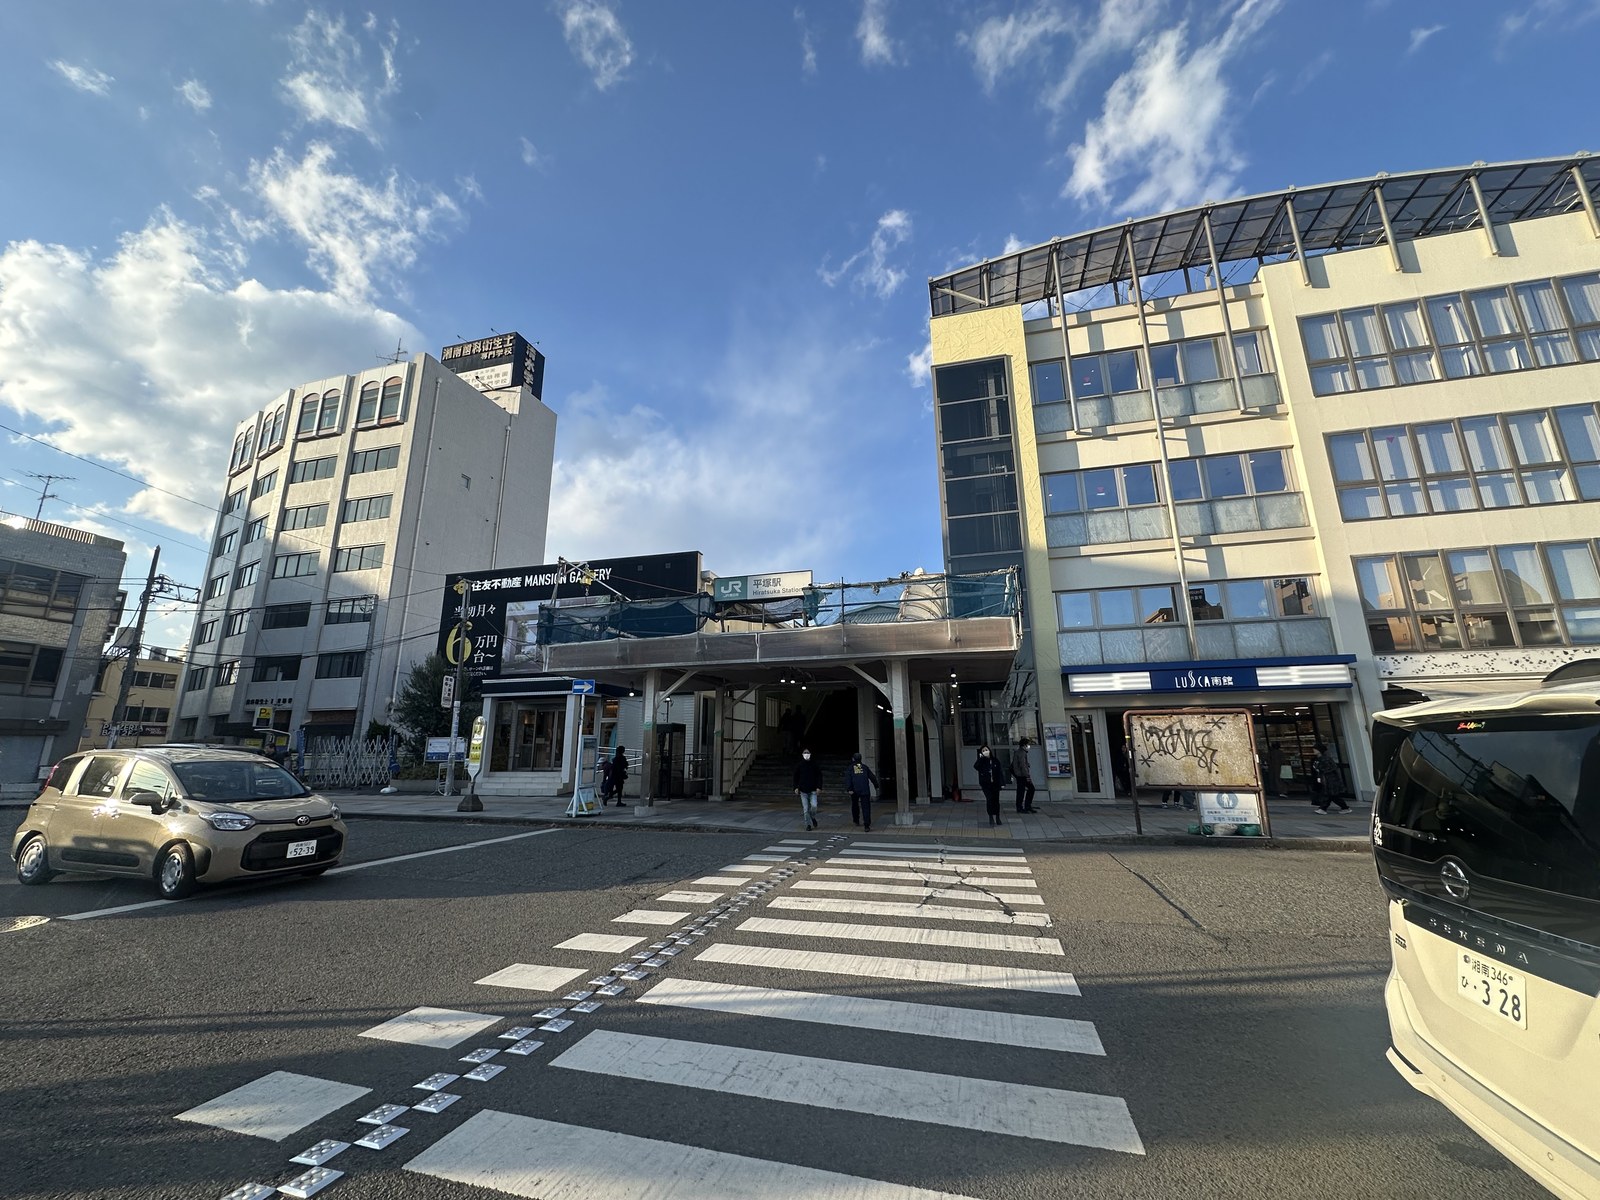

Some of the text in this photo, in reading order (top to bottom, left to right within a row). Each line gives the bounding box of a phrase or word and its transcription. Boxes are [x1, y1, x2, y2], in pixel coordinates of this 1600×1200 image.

[471, 577, 522, 592] 住友不動産
[720, 580, 742, 594] JR
[752, 577, 782, 589] 平塚駅
[752, 588, 781, 596] Hiratsuka
[475, 635, 498, 649] 万円
[293, 846, 315, 856] 52-39
[1428, 917, 1529, 964] SERENA
[1471, 958, 1509, 986] 湘南 346
[1461, 975, 1469, 988] ひ
